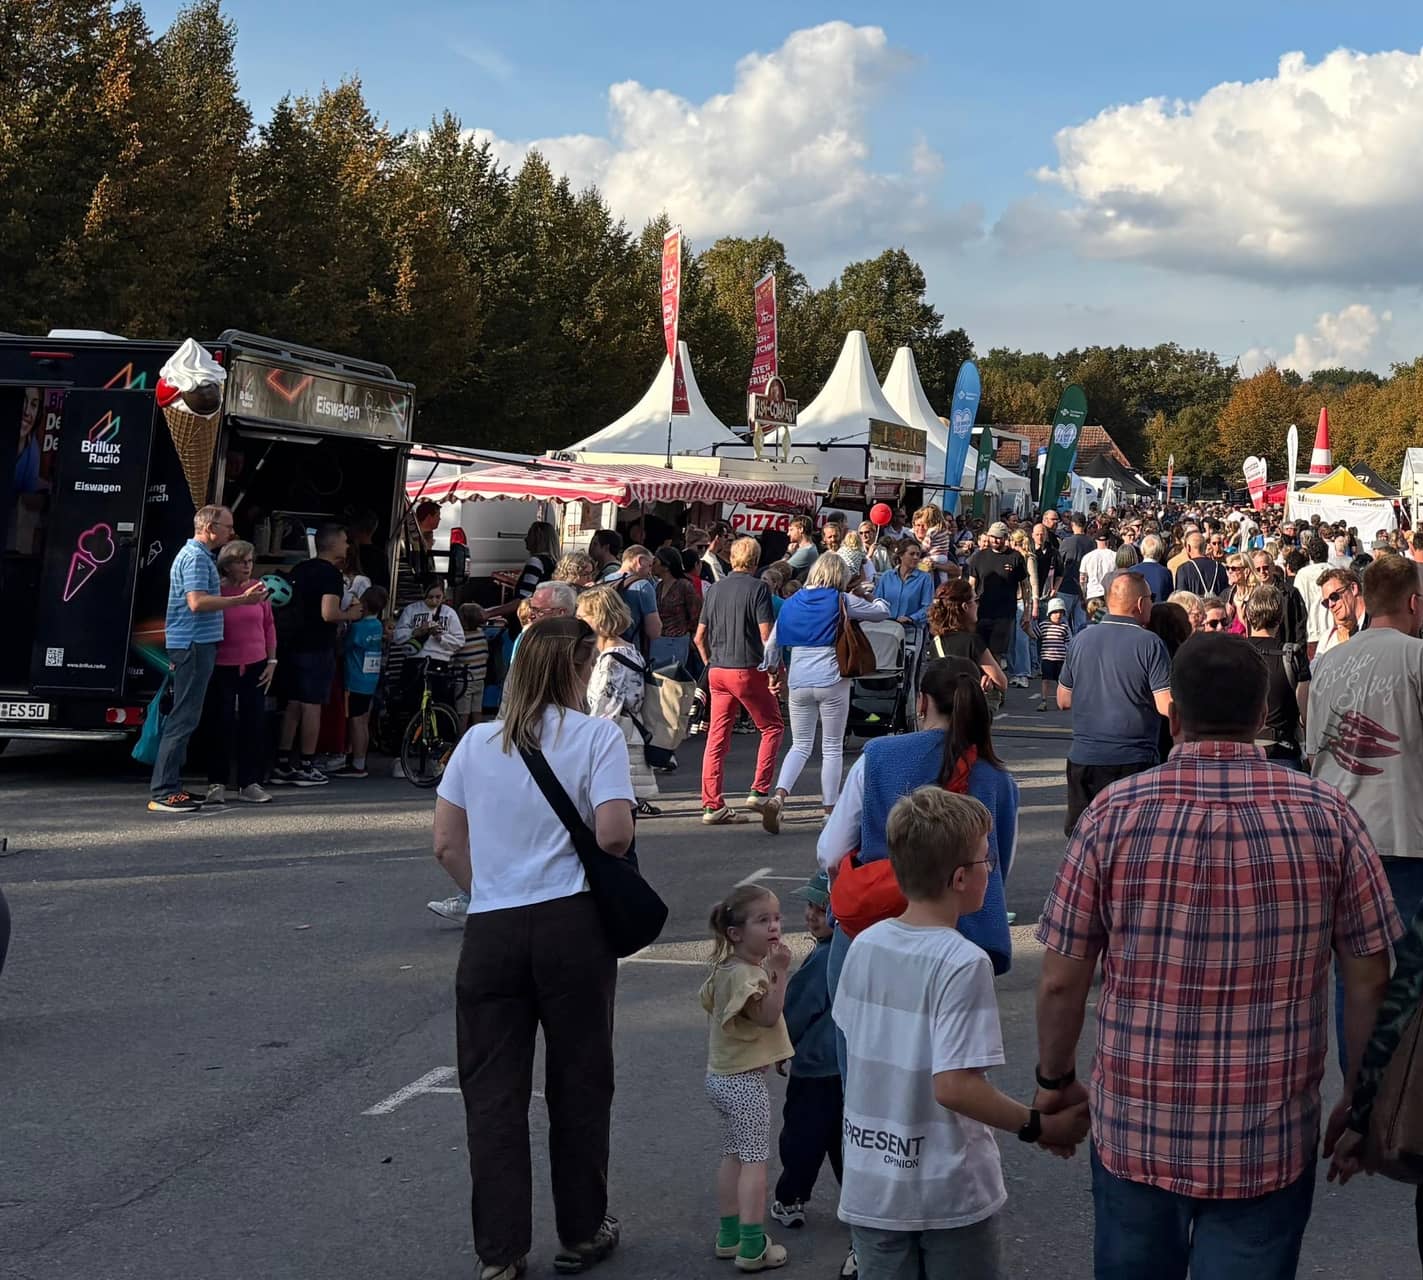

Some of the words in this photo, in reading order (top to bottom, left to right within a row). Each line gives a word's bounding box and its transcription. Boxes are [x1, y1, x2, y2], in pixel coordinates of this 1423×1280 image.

[315, 395, 361, 422] Eiswagen
[81, 440, 121, 454] Brillux
[88, 453, 120, 464] Radio
[74, 481, 121, 493] Eiswagen
[732, 514, 790, 532] PIZZA
[1313, 653, 1376, 696] Extra
[1336, 671, 1401, 719] Spicy
[9, 703, 26, 718] ES
[28, 703, 45, 718] 50
[883, 1154, 920, 1169] OPINION
